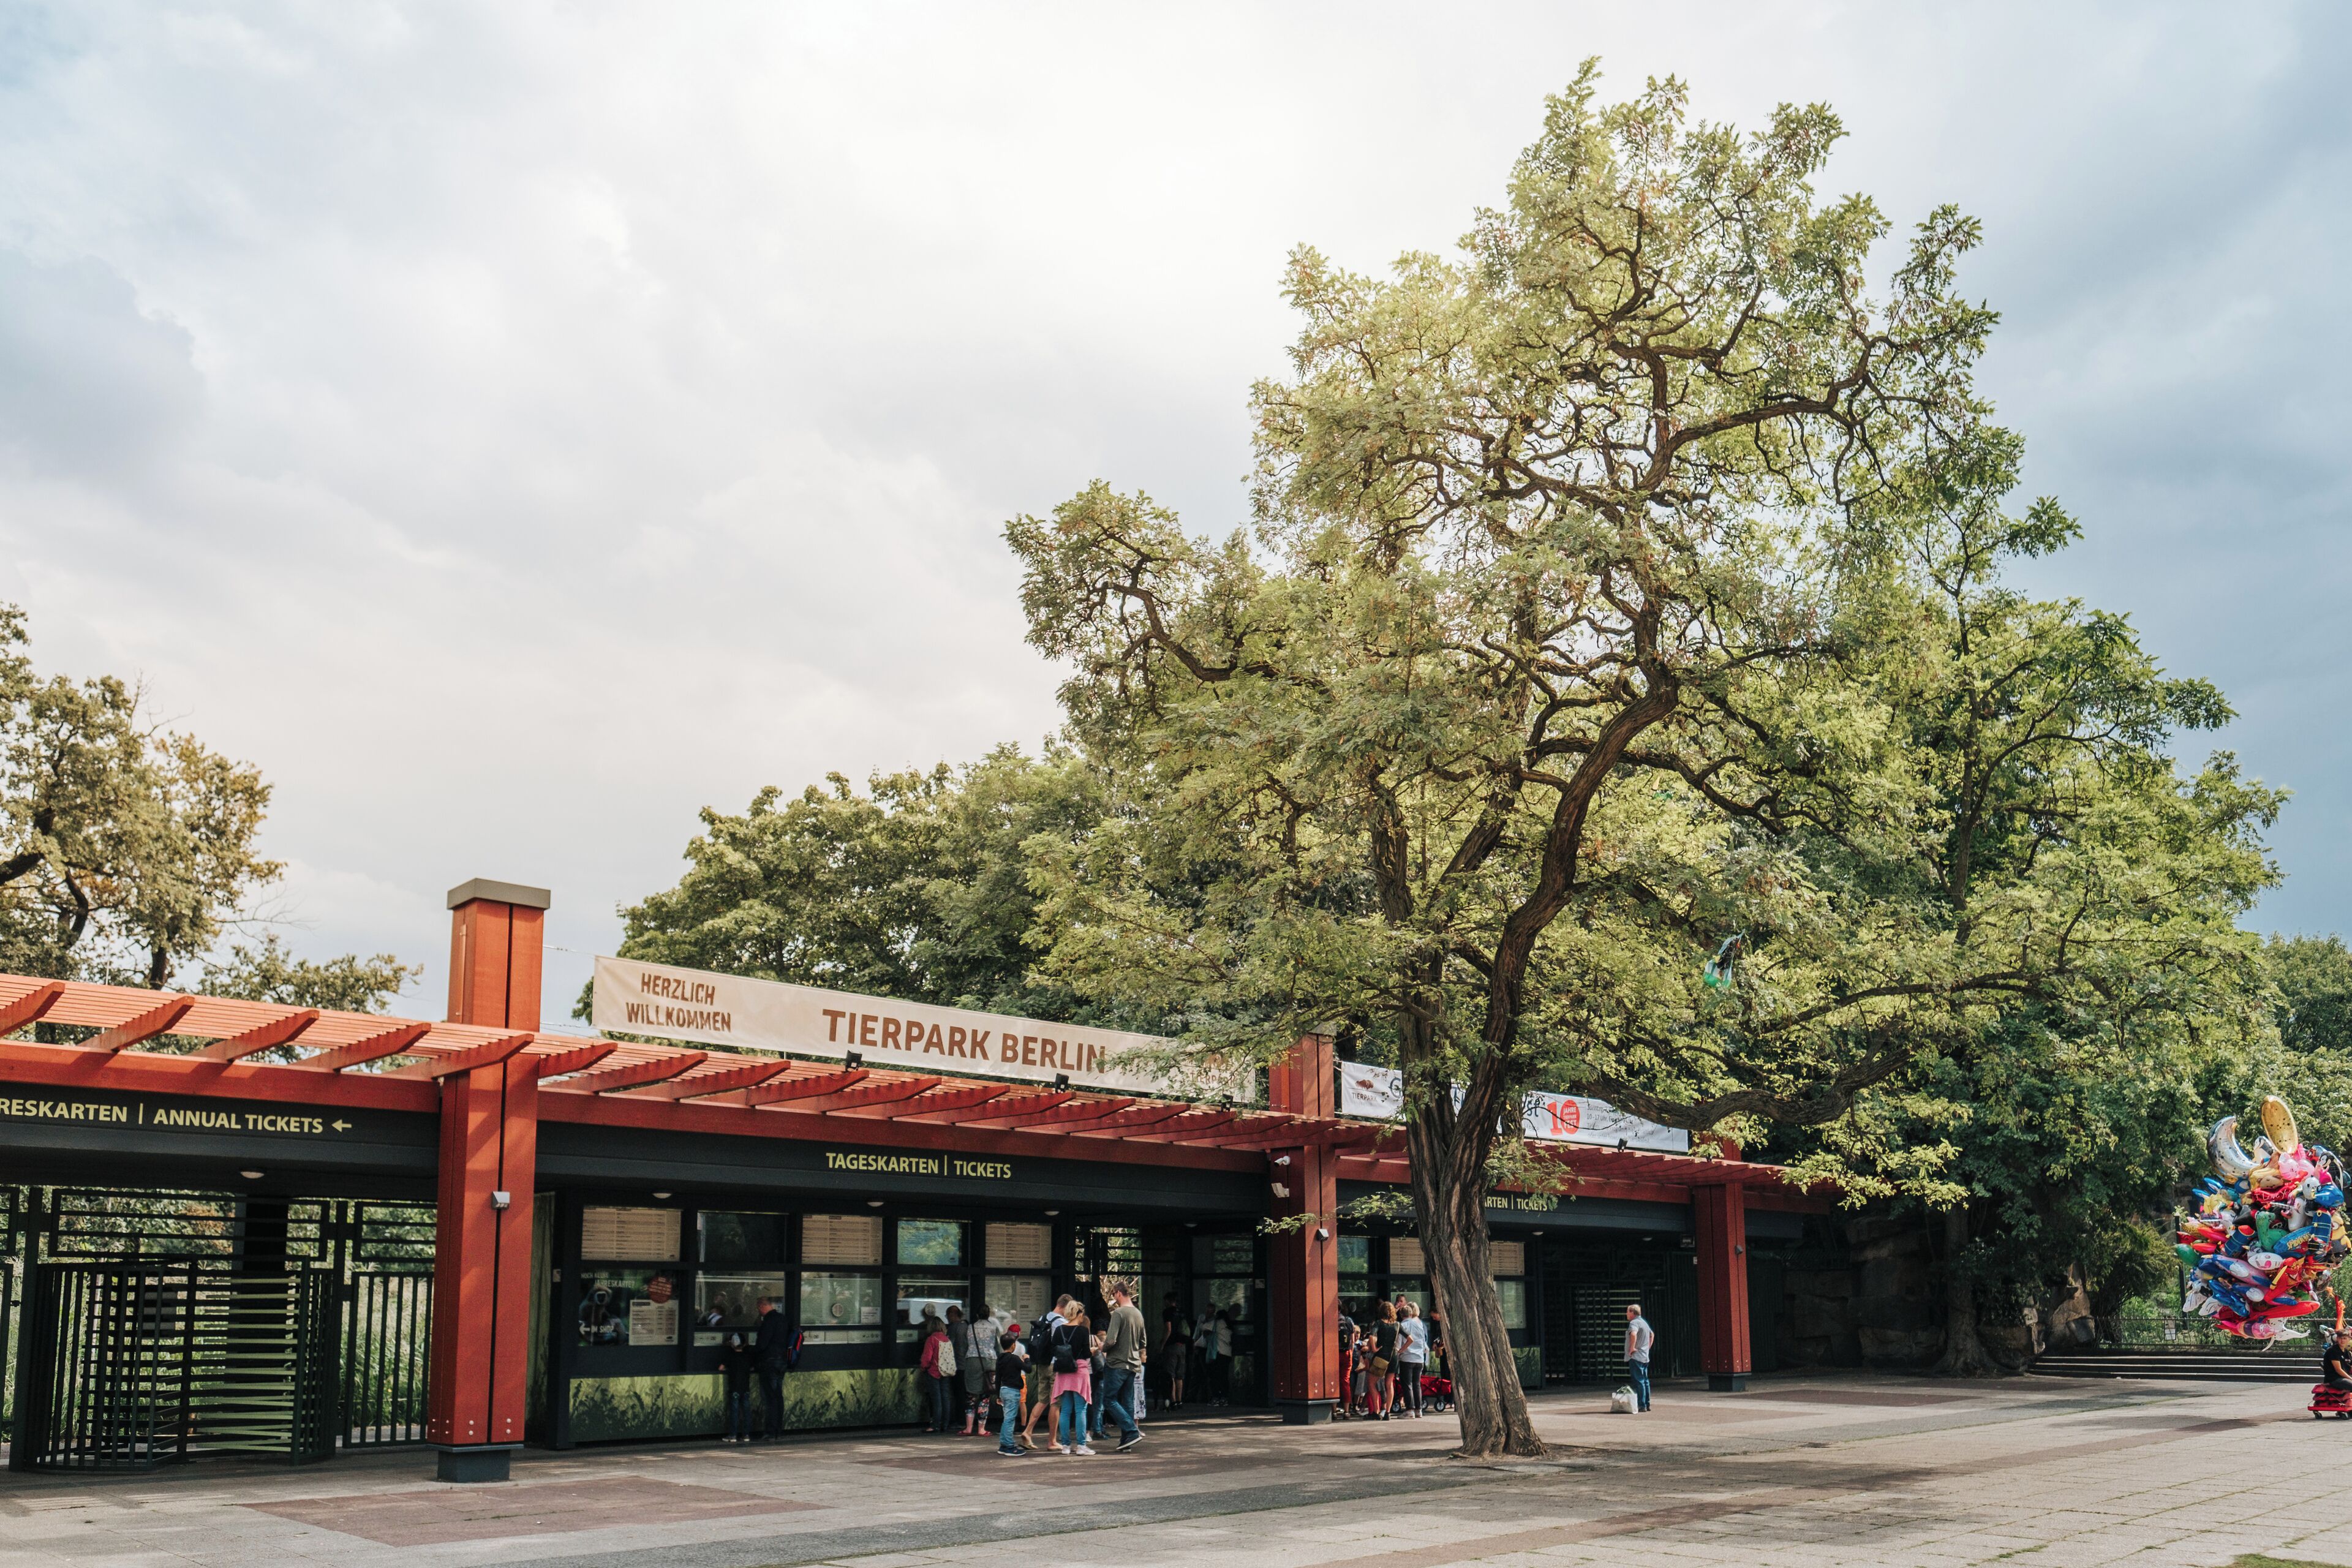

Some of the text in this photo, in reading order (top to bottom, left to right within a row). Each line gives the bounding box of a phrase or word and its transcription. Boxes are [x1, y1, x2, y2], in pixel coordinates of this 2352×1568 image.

[641, 973, 715, 1006] HERZLICH
[625, 1002, 731, 1033] WILLKOMMEN
[822, 1009, 1106, 1074] TIERPARK BERLIN
[1351, 1092, 1378, 1103] TIERPARK
[0, 1098, 323, 1134] RESKARTEN ANNUAL TICKETS
[1564, 1120, 1577, 1129] FEST
[826, 1153, 1011, 1178] TAGESKARTEN TICKETS
[1516, 1198, 1548, 1212] TICKETS
[599, 1325, 614, 1333] SHOP
